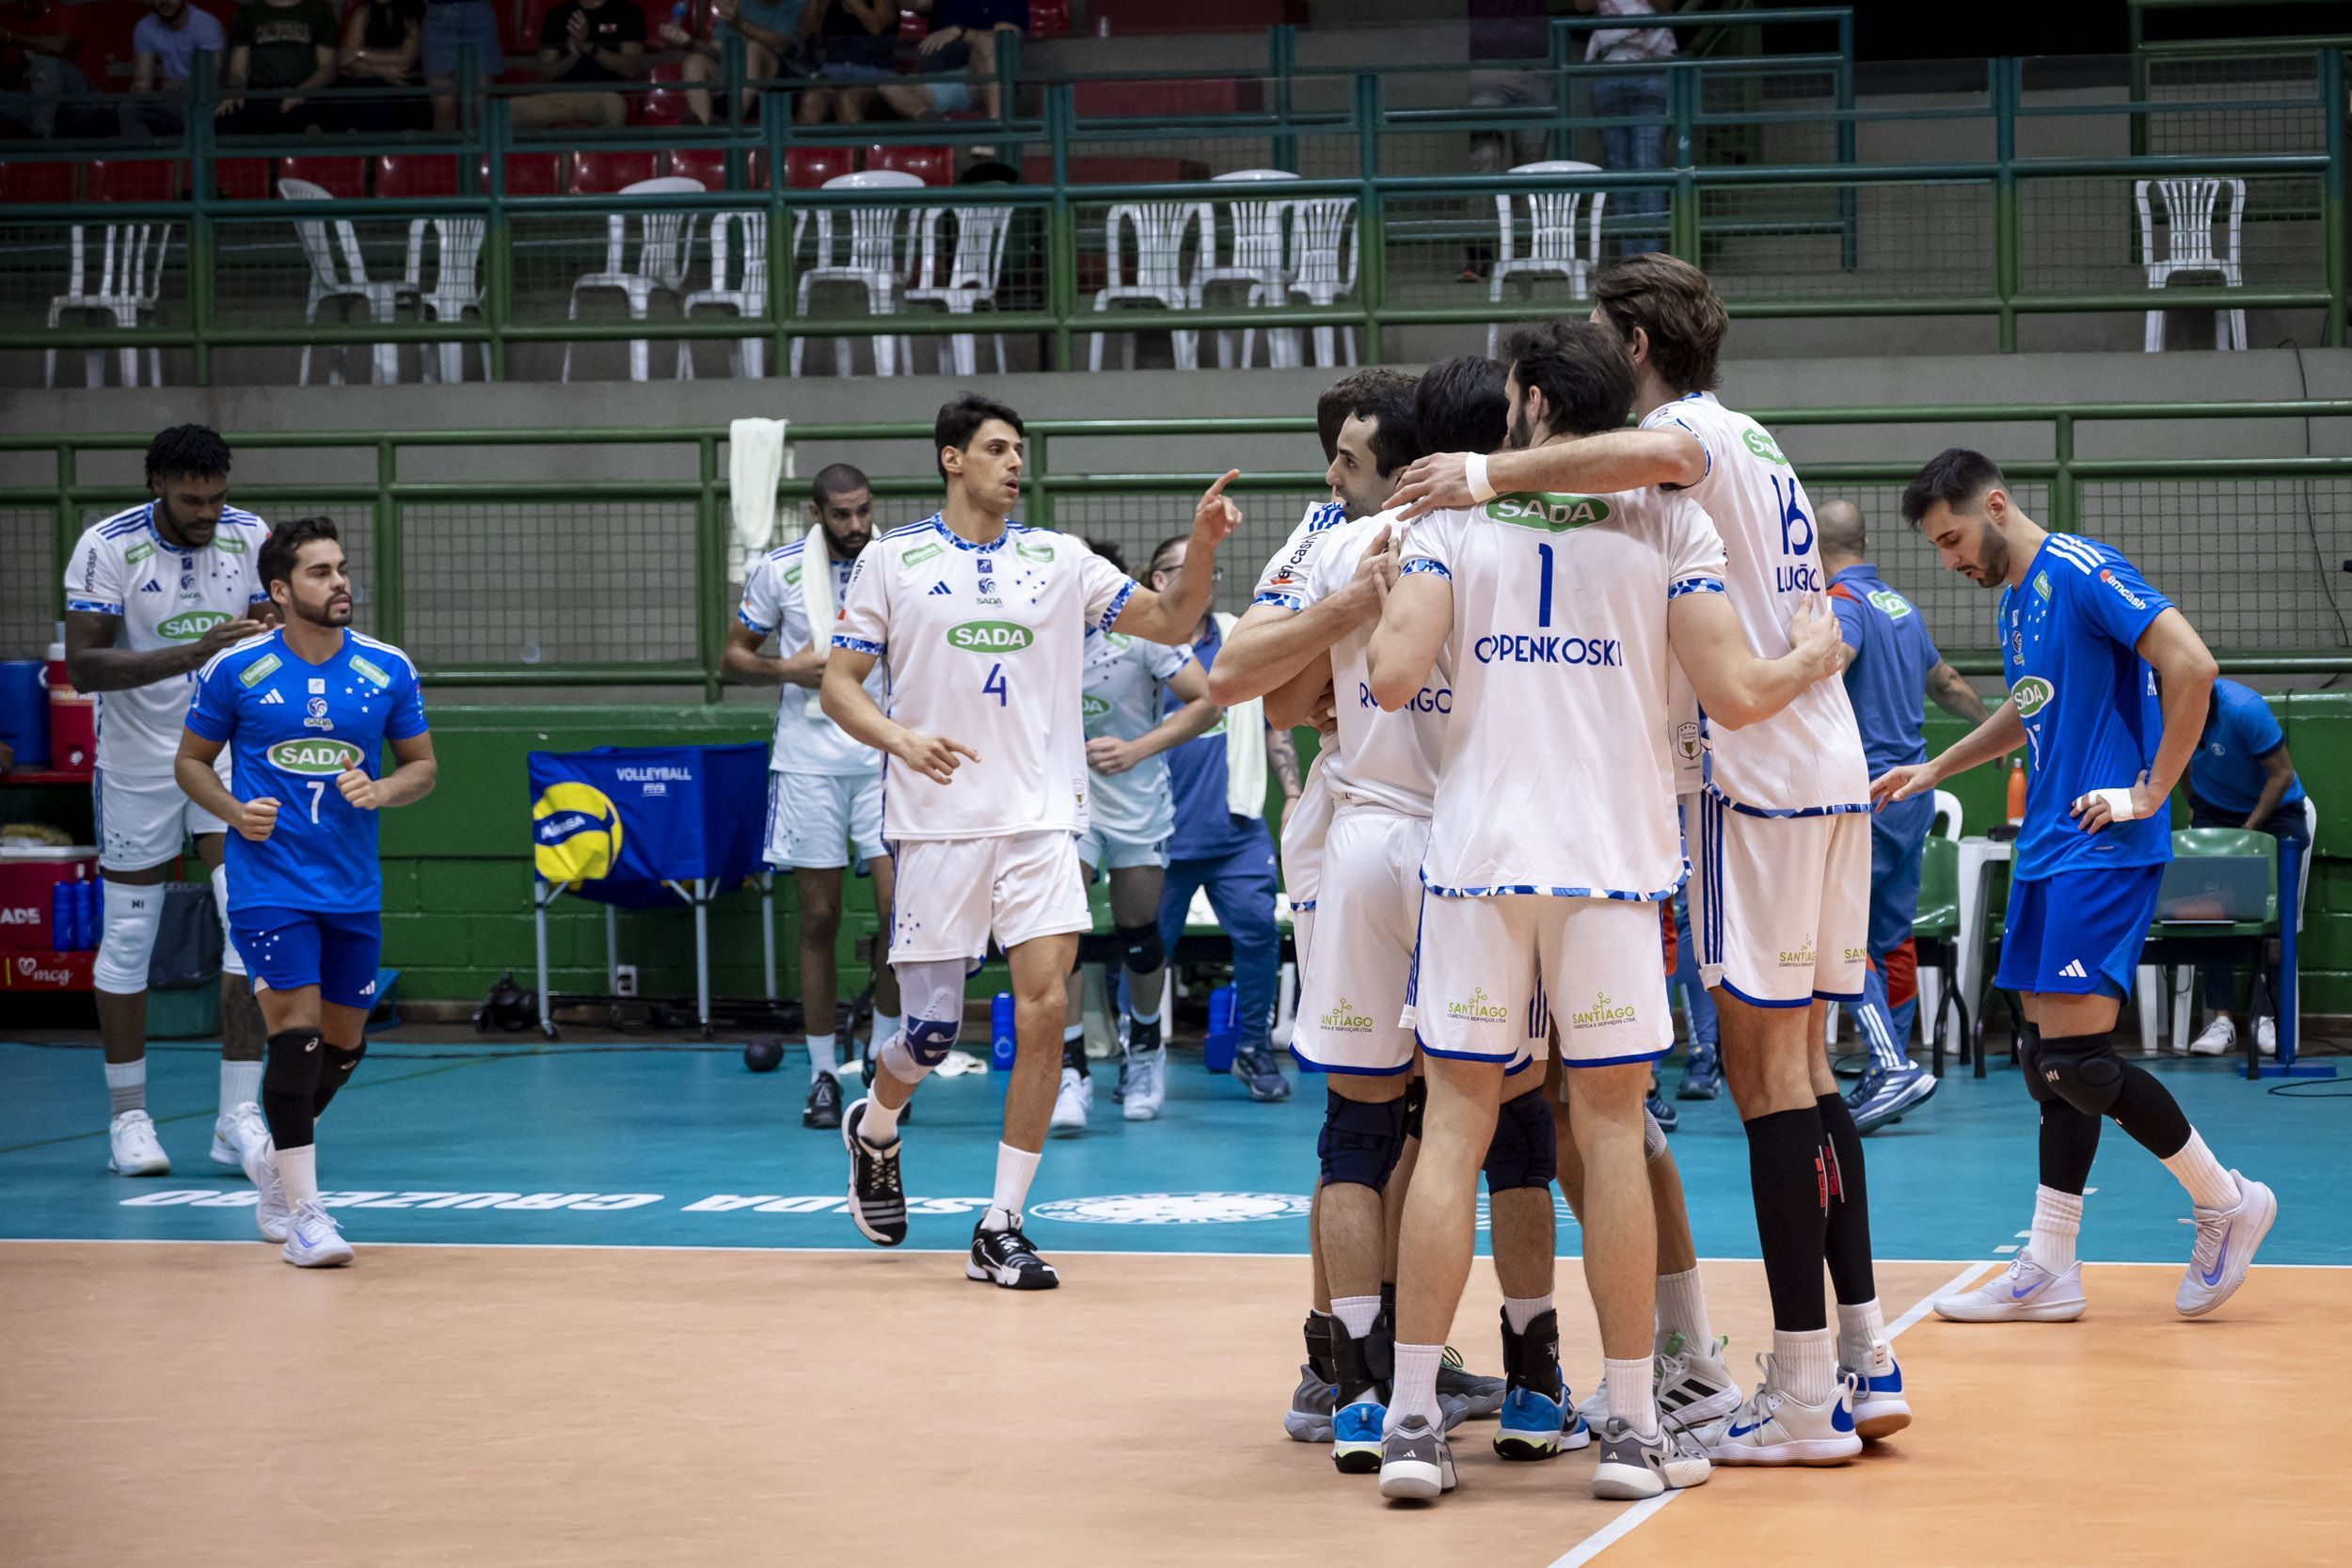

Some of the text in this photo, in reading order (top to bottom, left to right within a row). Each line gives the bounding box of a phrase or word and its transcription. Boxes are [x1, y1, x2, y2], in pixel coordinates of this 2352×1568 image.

[1496, 498, 1596, 524] SADA
[1771, 473, 1814, 556] 16
[1538, 543, 1554, 627] 1
[2106, 575, 2147, 610] emcash
[165, 615, 227, 637] SADA
[954, 627, 1026, 647] SADA
[981, 663, 1007, 707] 4
[279, 747, 351, 766] SADA
[616, 767, 692, 782] VOLLEYBALL
[306, 781, 326, 825] 7
[1449, 1002, 1508, 1018] SANTIAGO
[1572, 1006, 1635, 1024] SANTIAGO
[119, 1189, 664, 1212] CRUZERO
